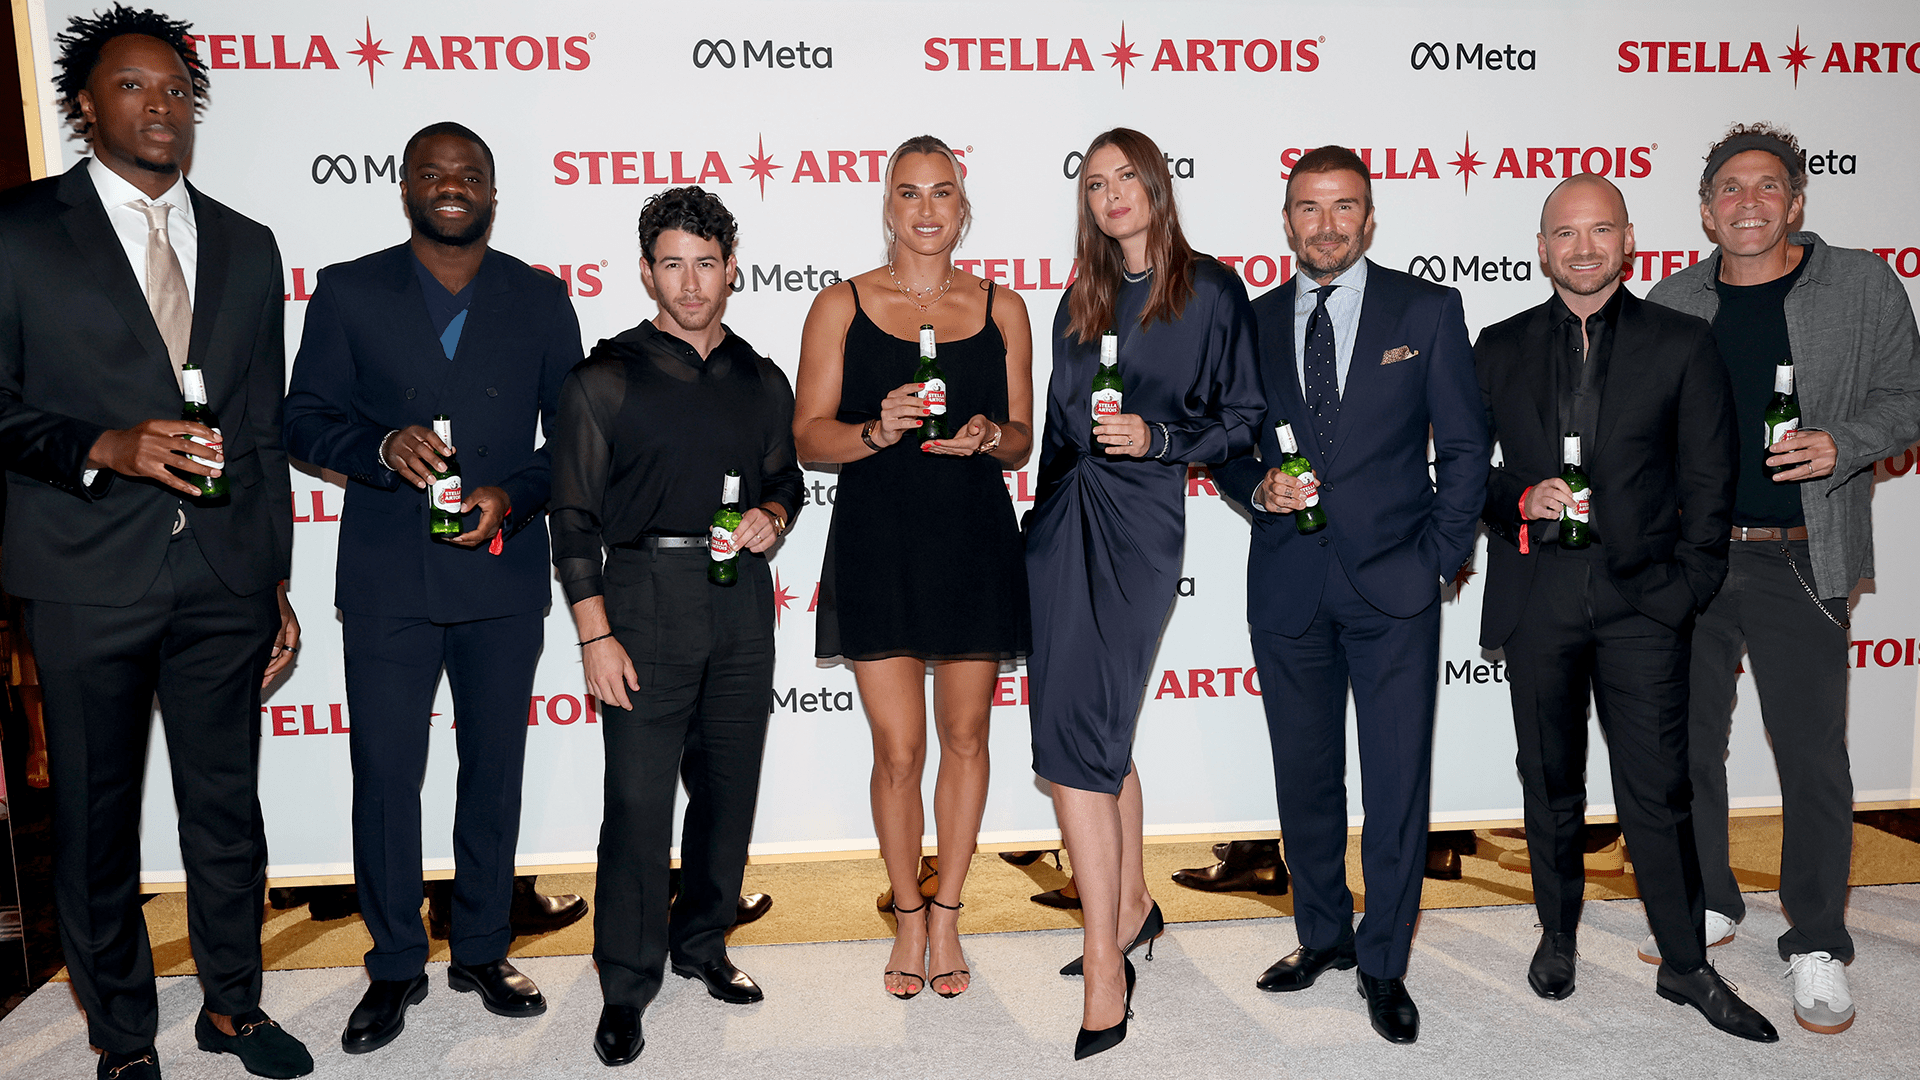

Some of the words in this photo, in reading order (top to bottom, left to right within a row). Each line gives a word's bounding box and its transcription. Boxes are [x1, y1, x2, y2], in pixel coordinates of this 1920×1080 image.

[743, 40, 833, 70] Meta
[924, 37, 1095, 72] STELLA
[1456, 42, 1537, 71] Meta
[1618, 40, 1771, 74] STELLA
[552, 151, 733, 186] STELLA
[1800, 148, 1857, 176] eta
[1451, 255, 1532, 283] Meta
[770, 687, 854, 715] Meta
